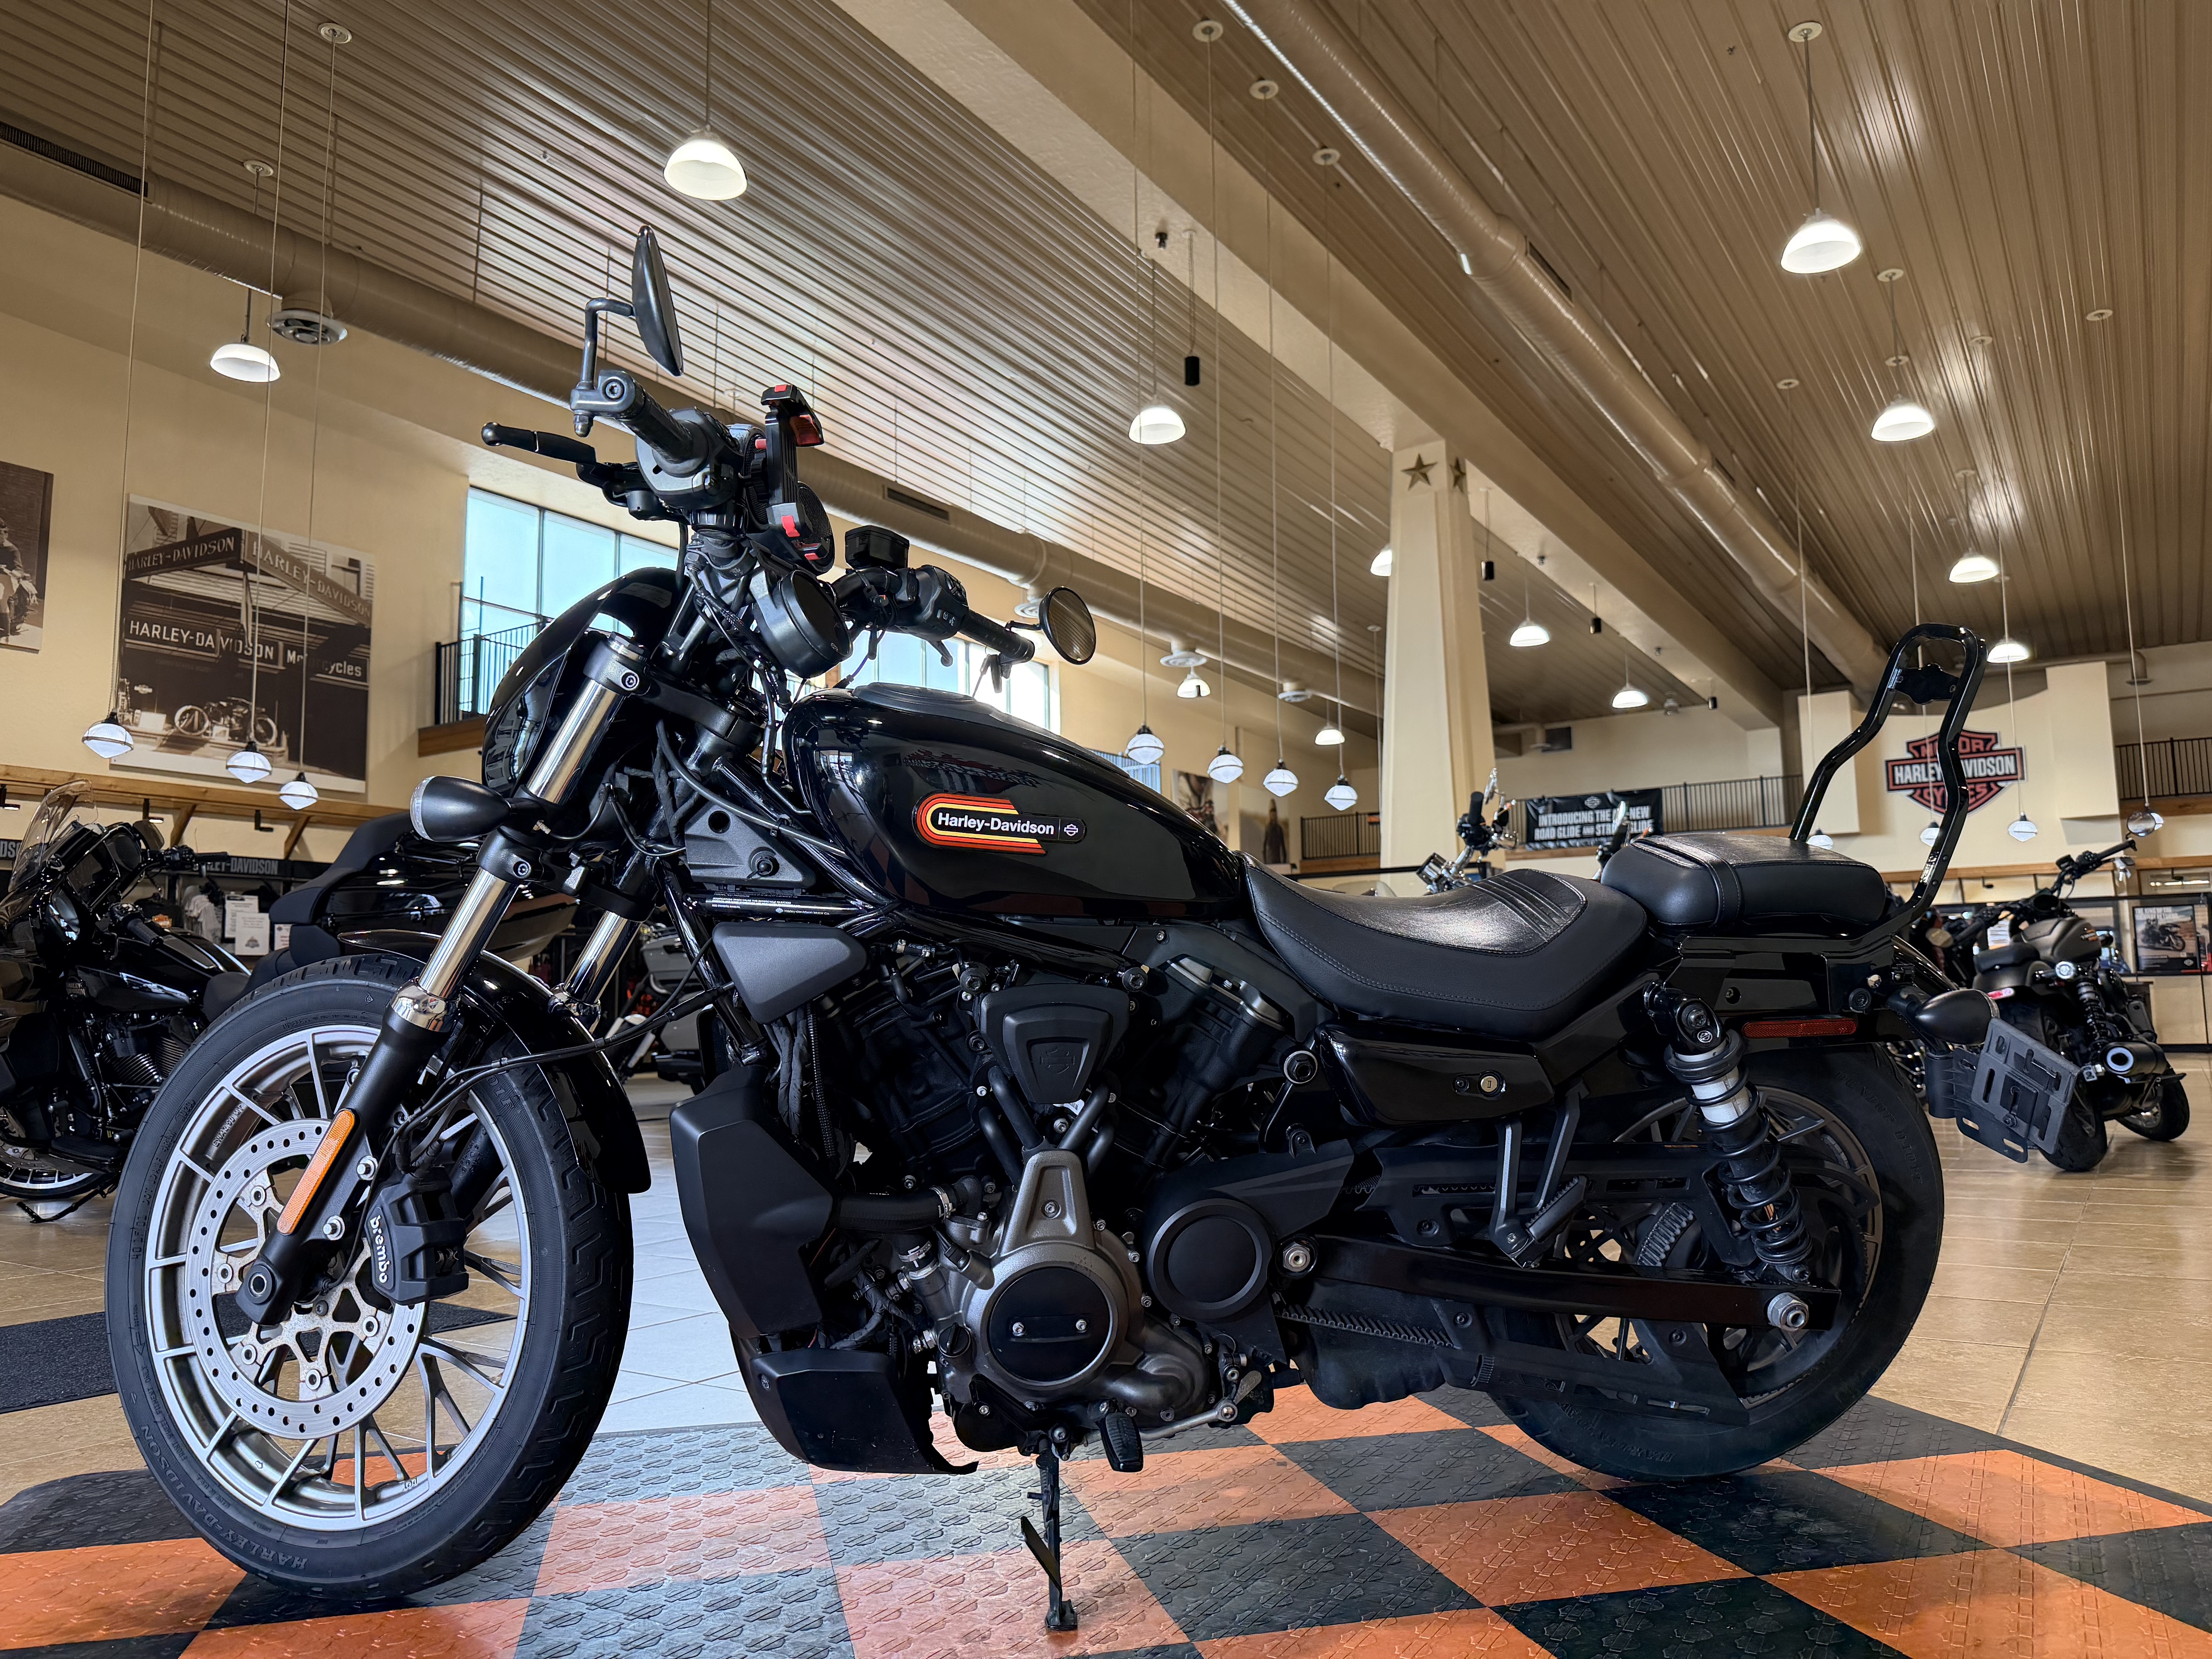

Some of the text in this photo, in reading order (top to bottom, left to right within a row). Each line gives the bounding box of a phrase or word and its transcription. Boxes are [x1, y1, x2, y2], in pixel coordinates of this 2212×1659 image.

[129, 536, 235, 570] HARLEY-DAVIDSON
[252, 541, 371, 617] HARLEY-DAVIDSON
[129, 620, 274, 660] HARLEY-DAVIDSON
[938, 812, 1054, 835] Harley-Davidson
[1534, 826, 1556, 841] ROAD
[1557, 824, 1582, 839] GLIDE
[1539, 812, 1594, 827] INTRODUCING
[1595, 809, 1612, 823] THE
[369, 1214, 390, 1283] brembo
[141, 1365, 151, 1383] ONLY
[172, 1437, 188, 1462] FRONT
[140, 1425, 309, 1570] HARLEY-DAVIDSON
